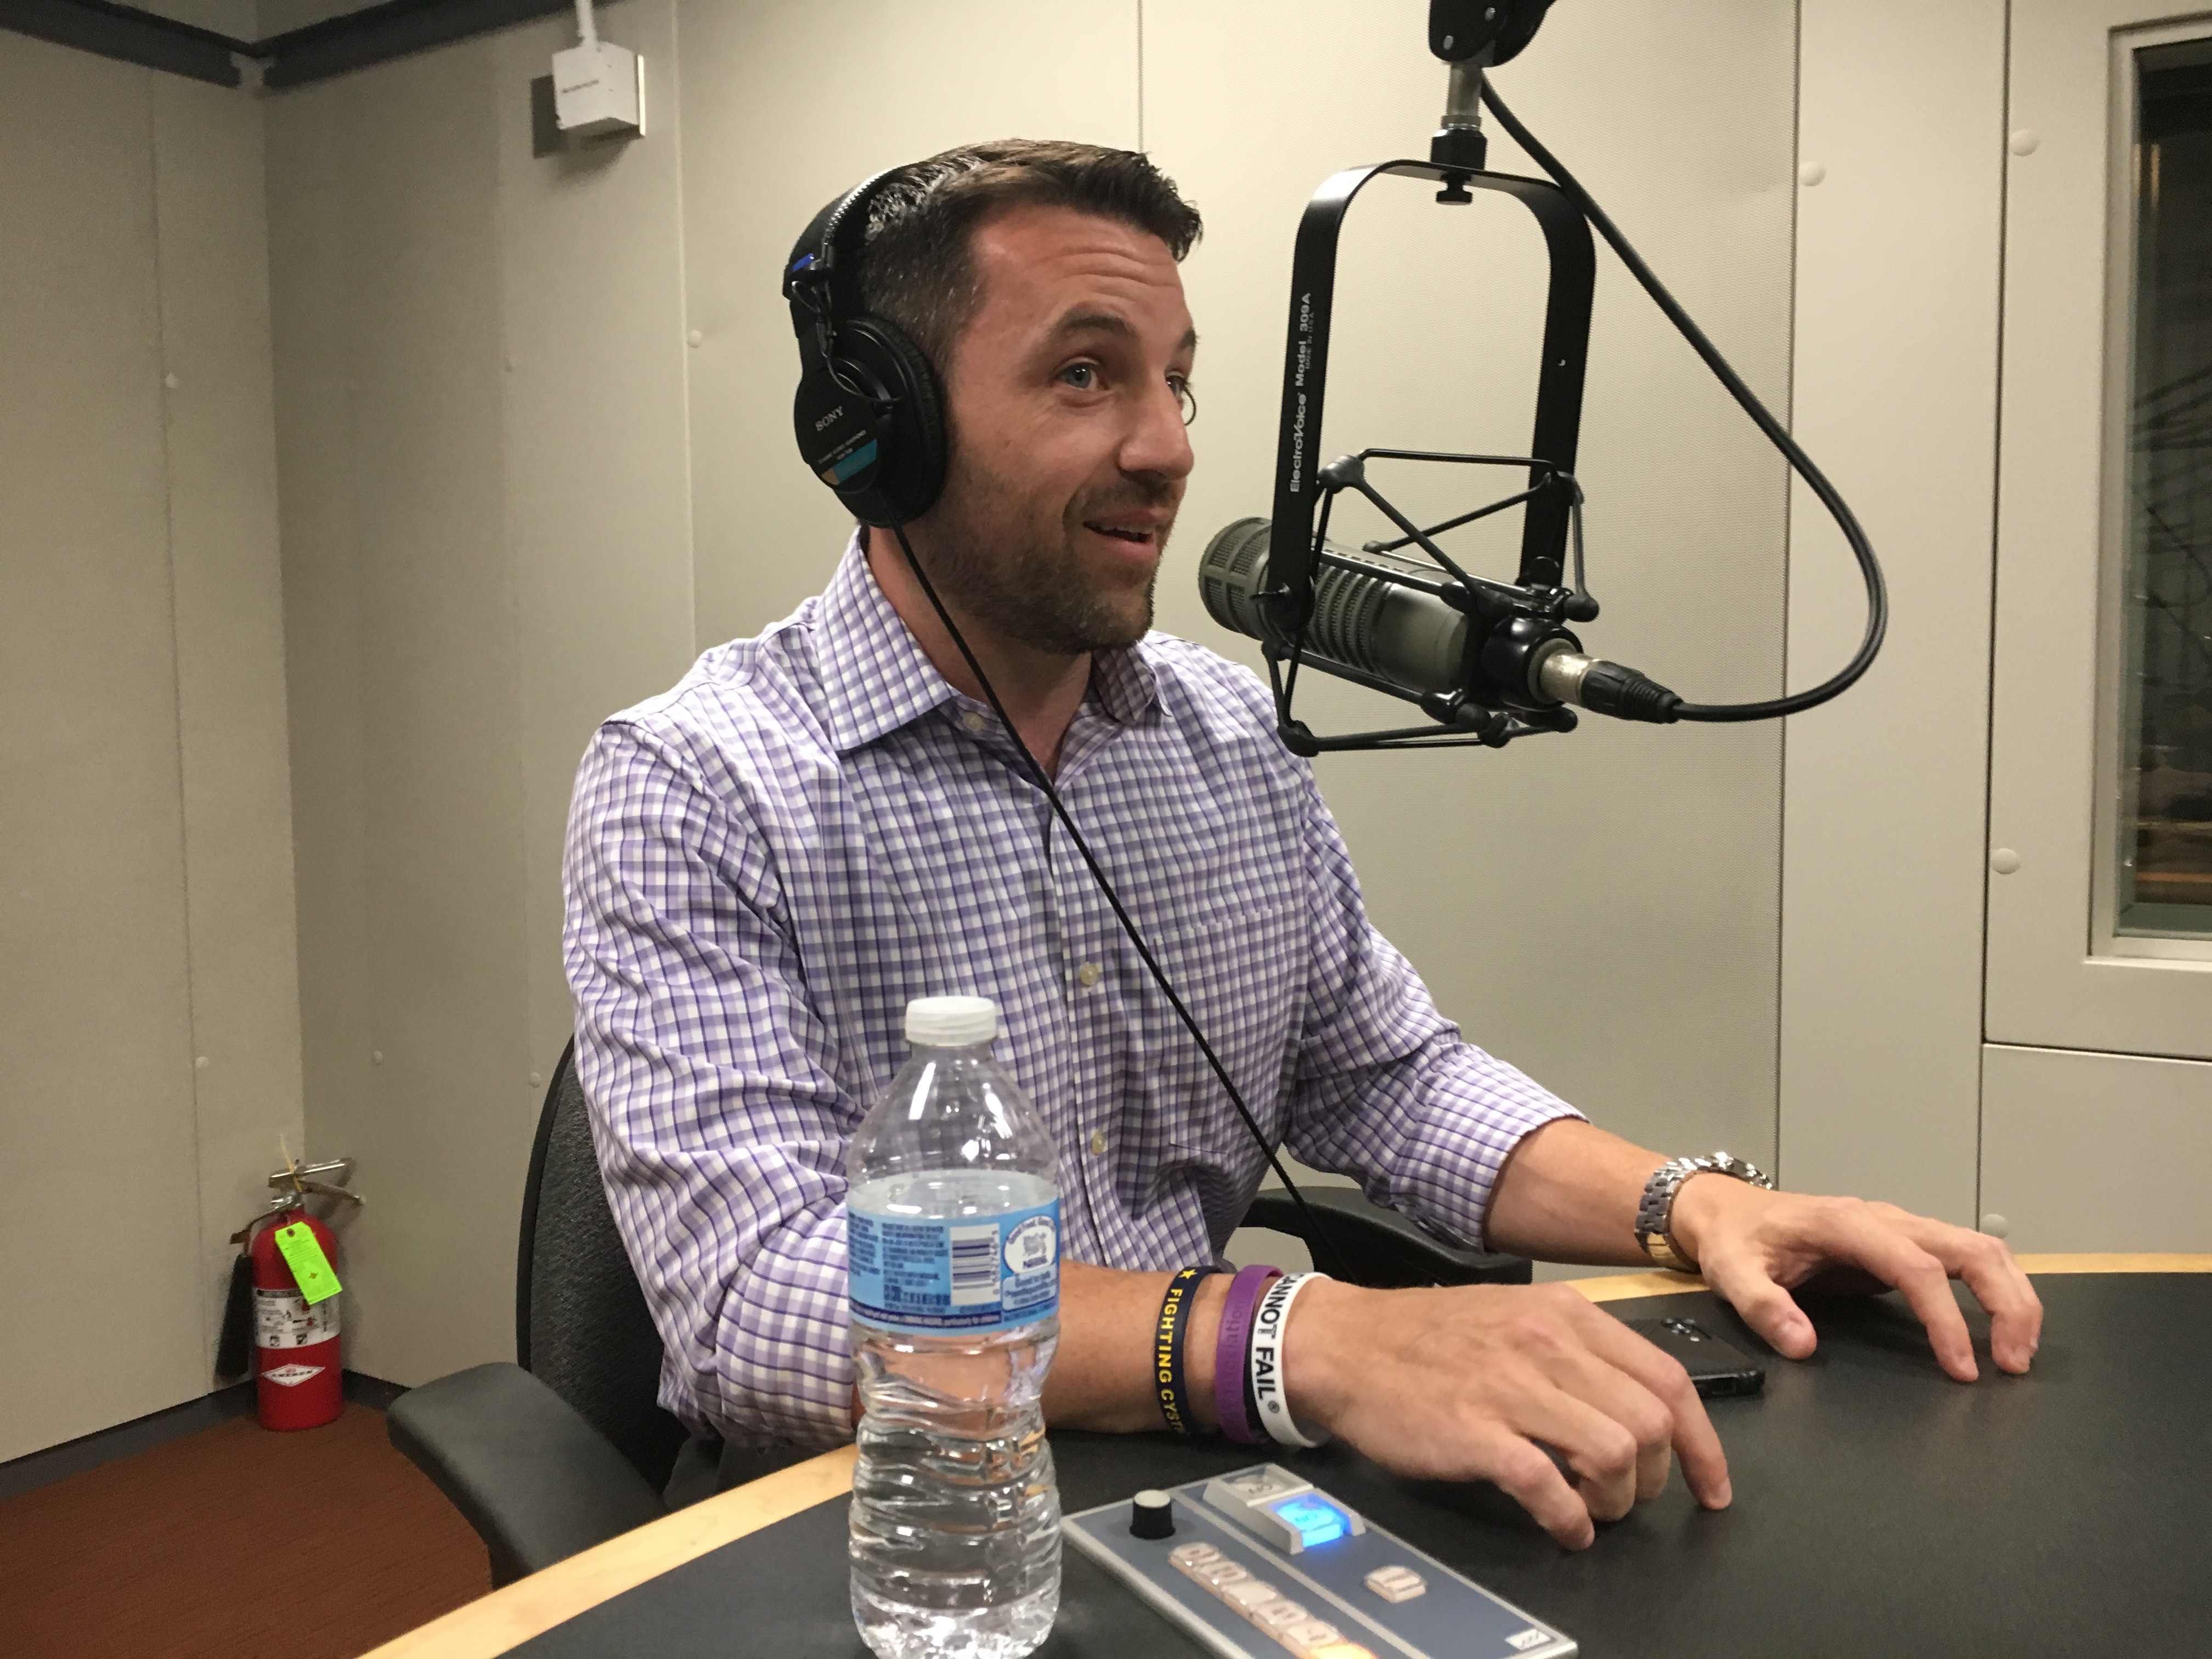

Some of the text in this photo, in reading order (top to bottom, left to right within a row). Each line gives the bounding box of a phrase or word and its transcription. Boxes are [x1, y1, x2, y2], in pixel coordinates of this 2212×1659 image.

[1299, 292, 1311, 332] 309A
[1295, 340, 1307, 387] Model
[815, 405, 843, 432] SONY
[1158, 1288, 1183, 1383] FIGHTING
[1255, 1273, 1305, 1400] ANNOT FAIL
